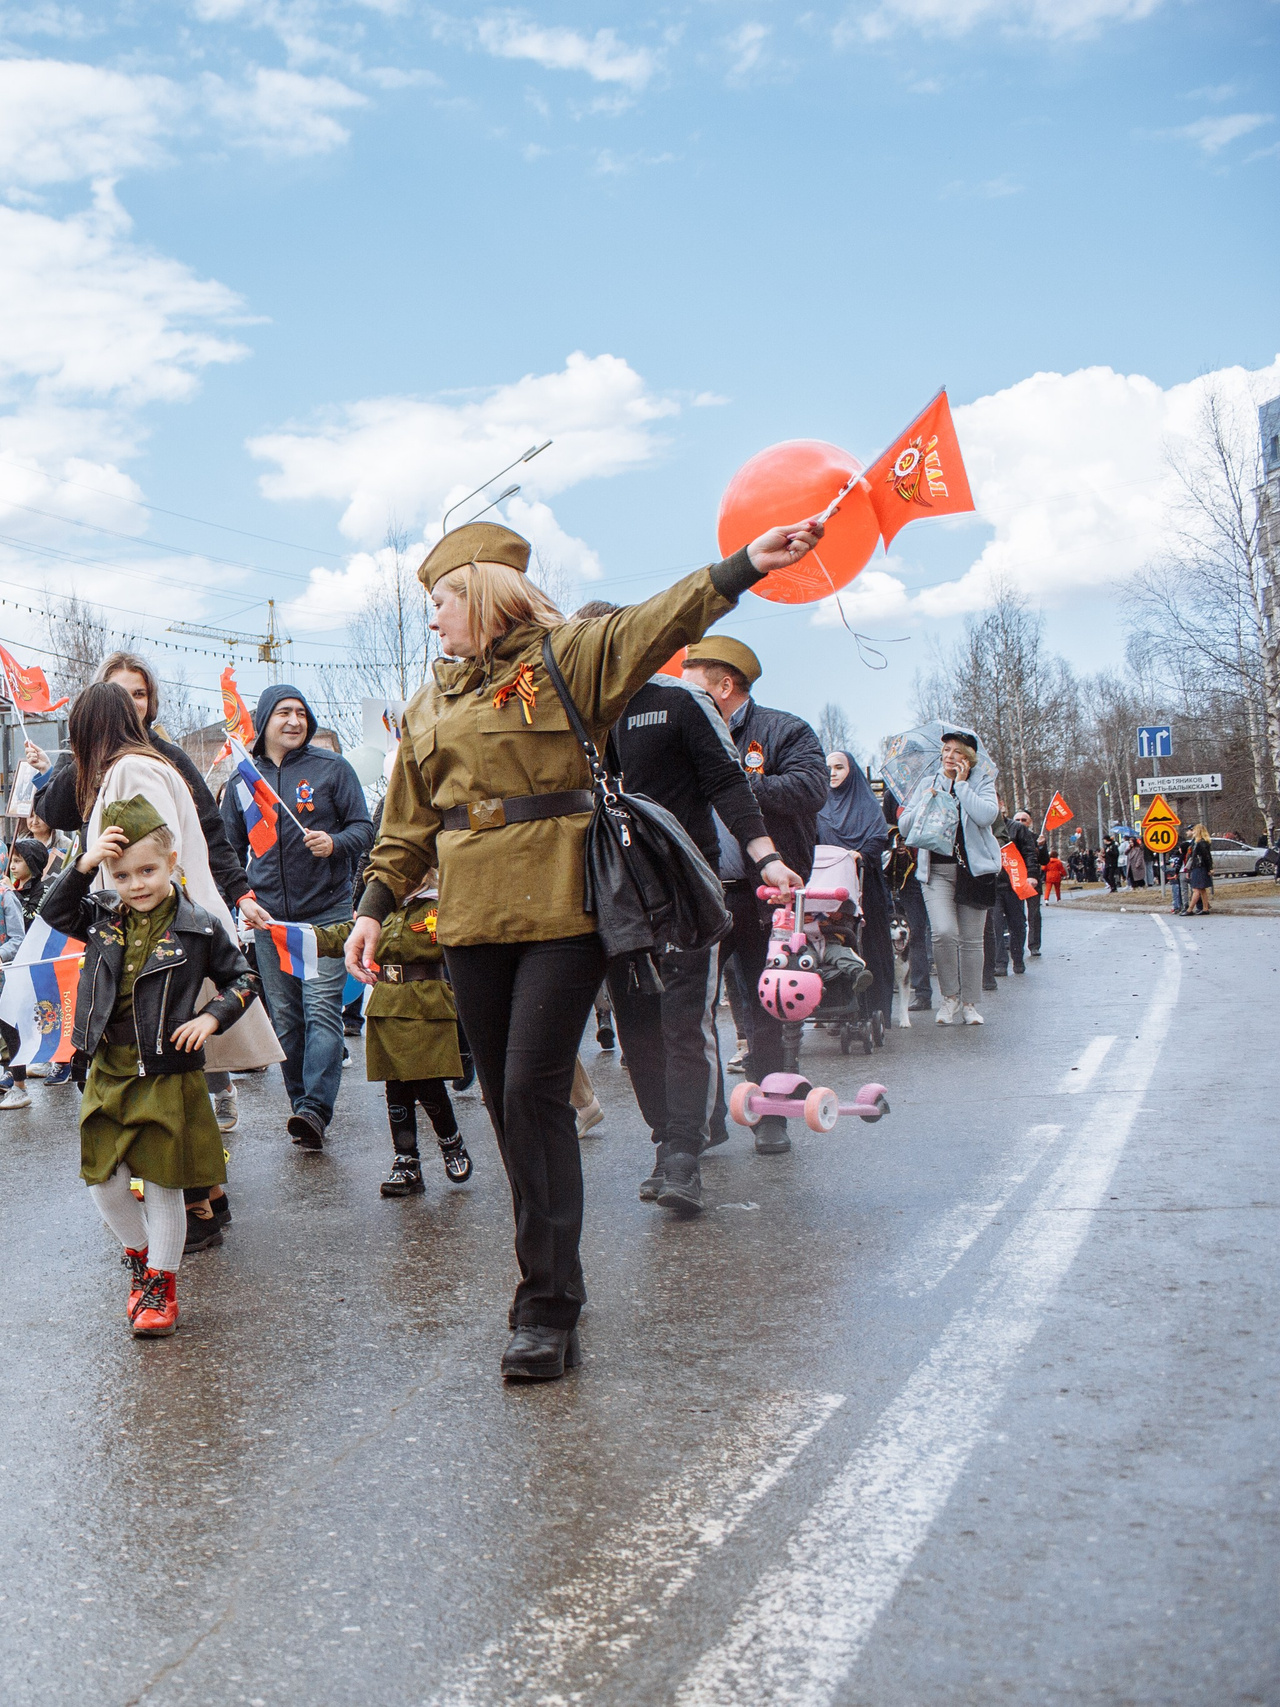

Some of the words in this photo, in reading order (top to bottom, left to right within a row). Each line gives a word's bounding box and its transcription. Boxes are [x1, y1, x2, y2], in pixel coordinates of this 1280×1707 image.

[627, 710, 668, 730] PUMA
[1157, 777, 1203, 786] НЕФТЯНИКОВ
[1149, 830, 1171, 845] 40
